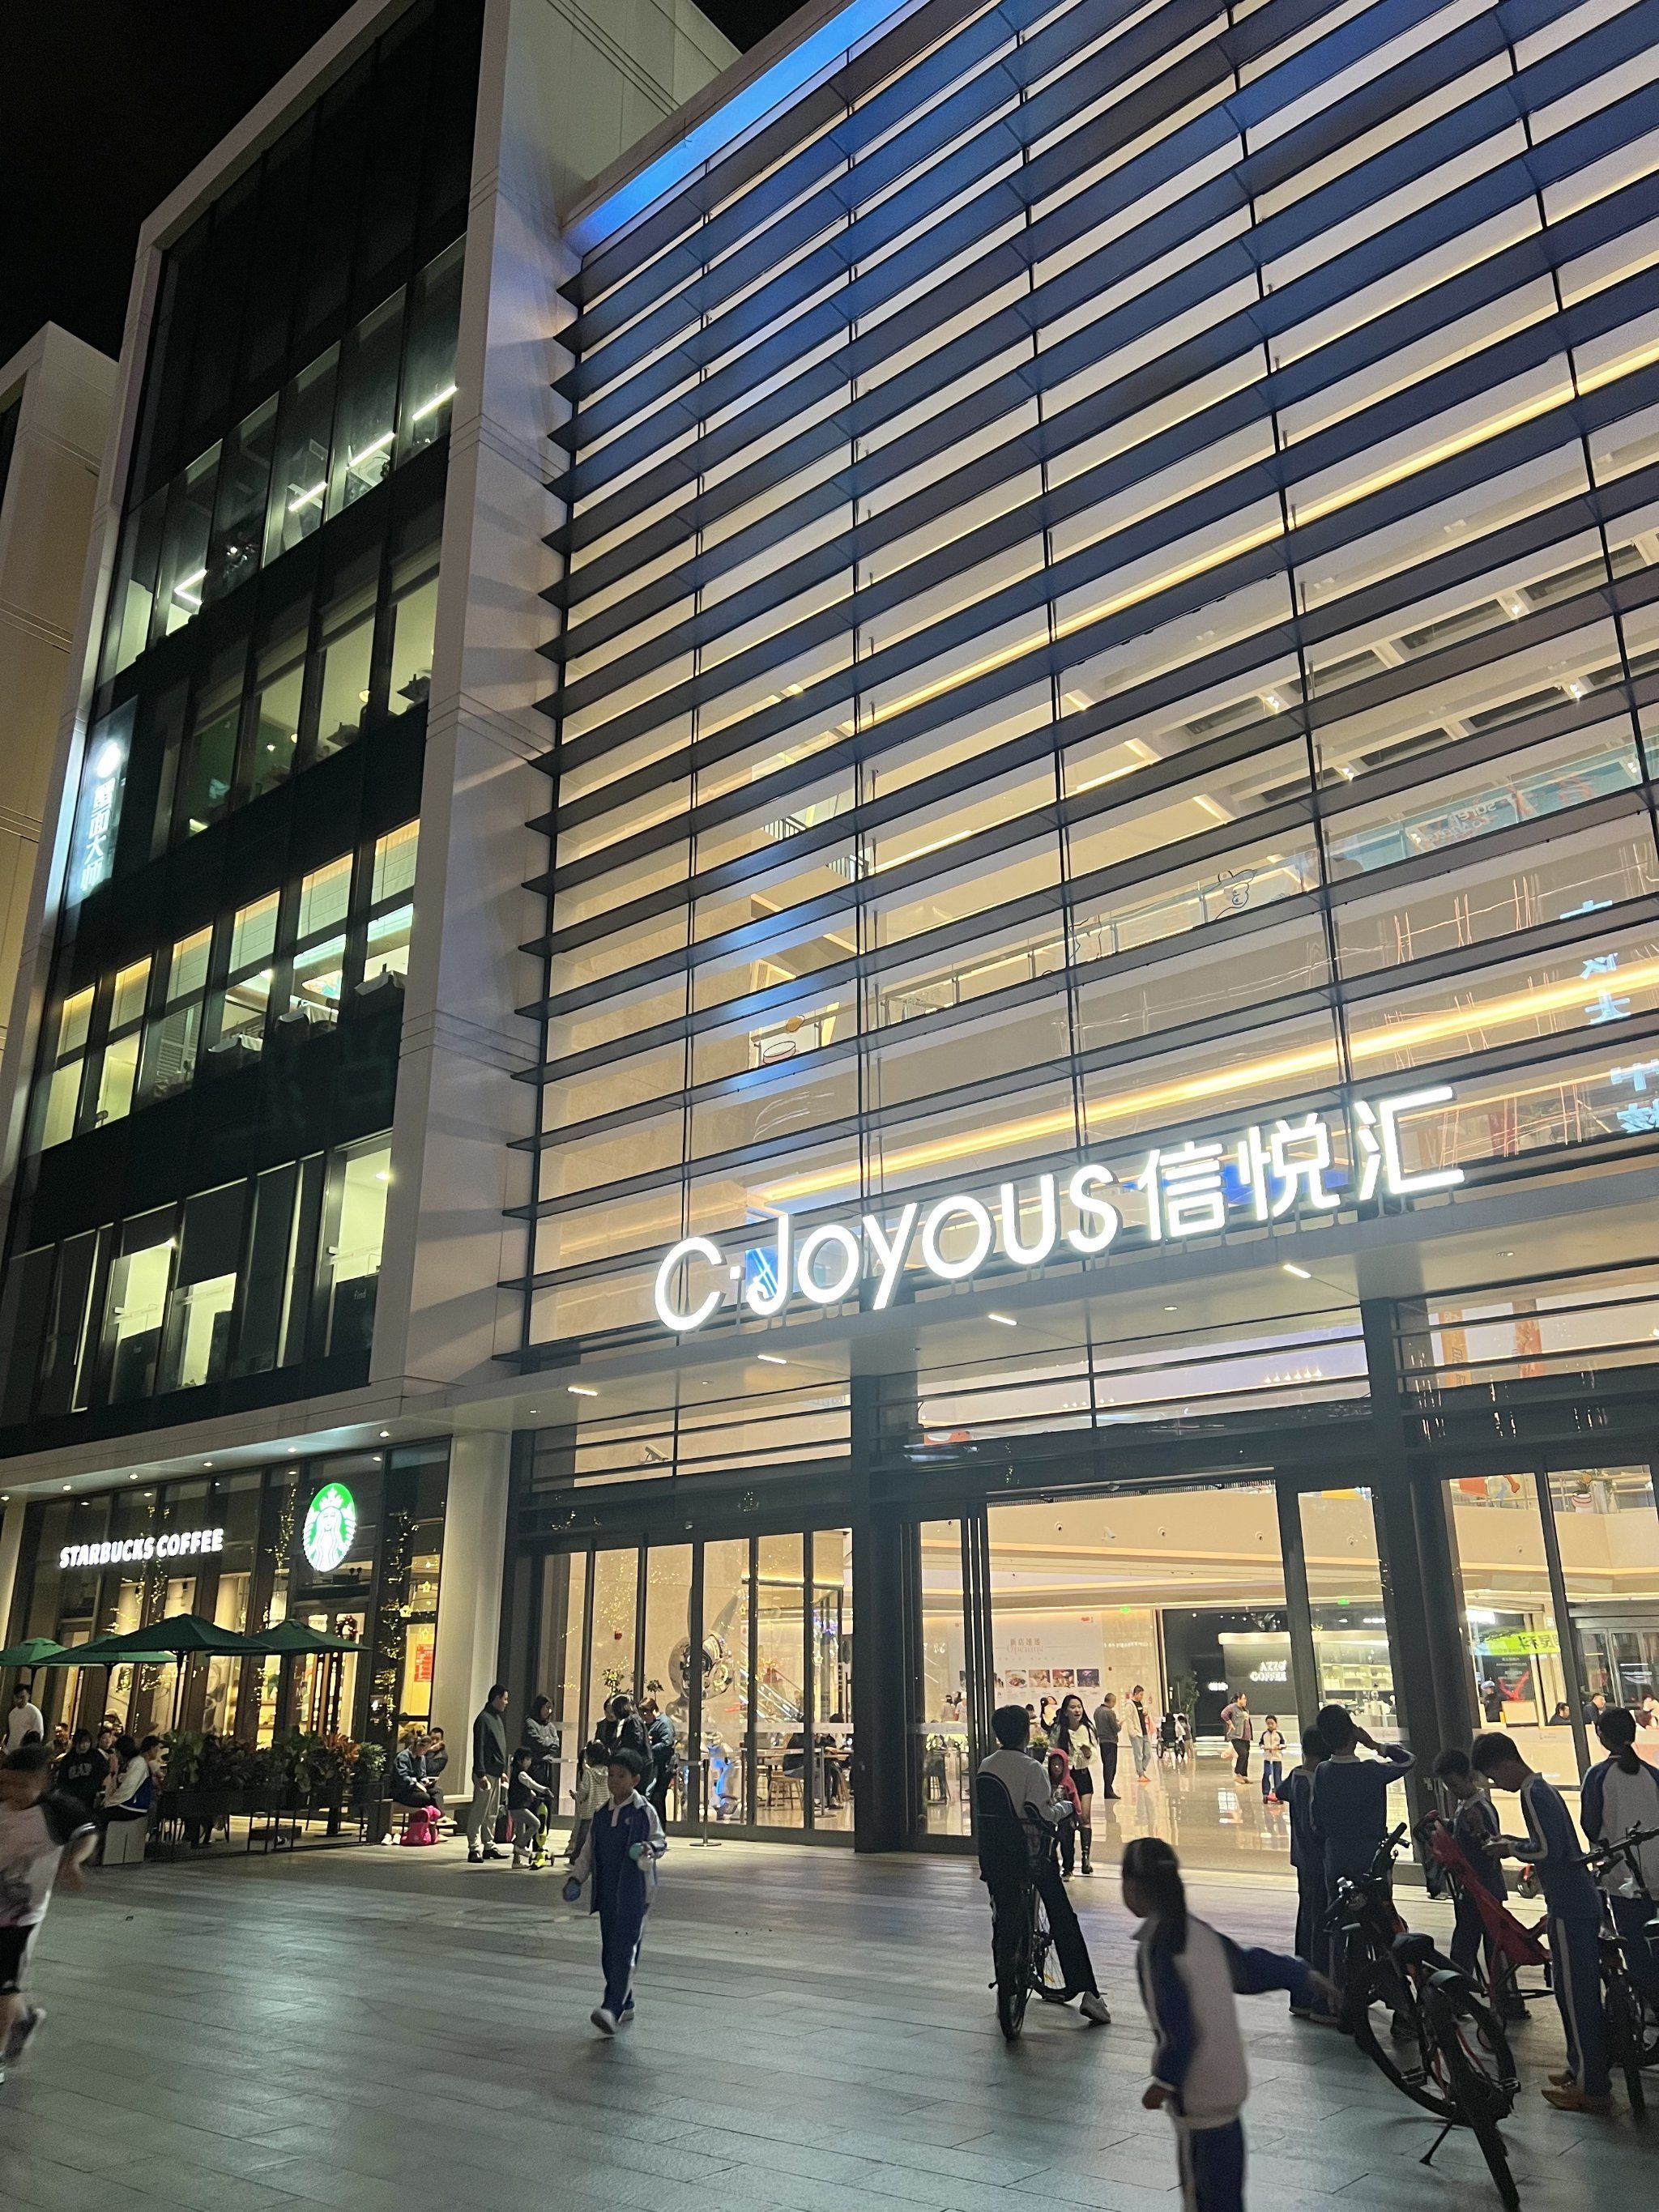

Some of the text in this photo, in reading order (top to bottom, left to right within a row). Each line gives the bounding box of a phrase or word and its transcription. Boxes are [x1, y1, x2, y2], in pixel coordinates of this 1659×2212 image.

[1137, 1086, 1466, 1241] 信悦汇
[59, 1528, 224, 1569] STARBUCKS COFFEE
